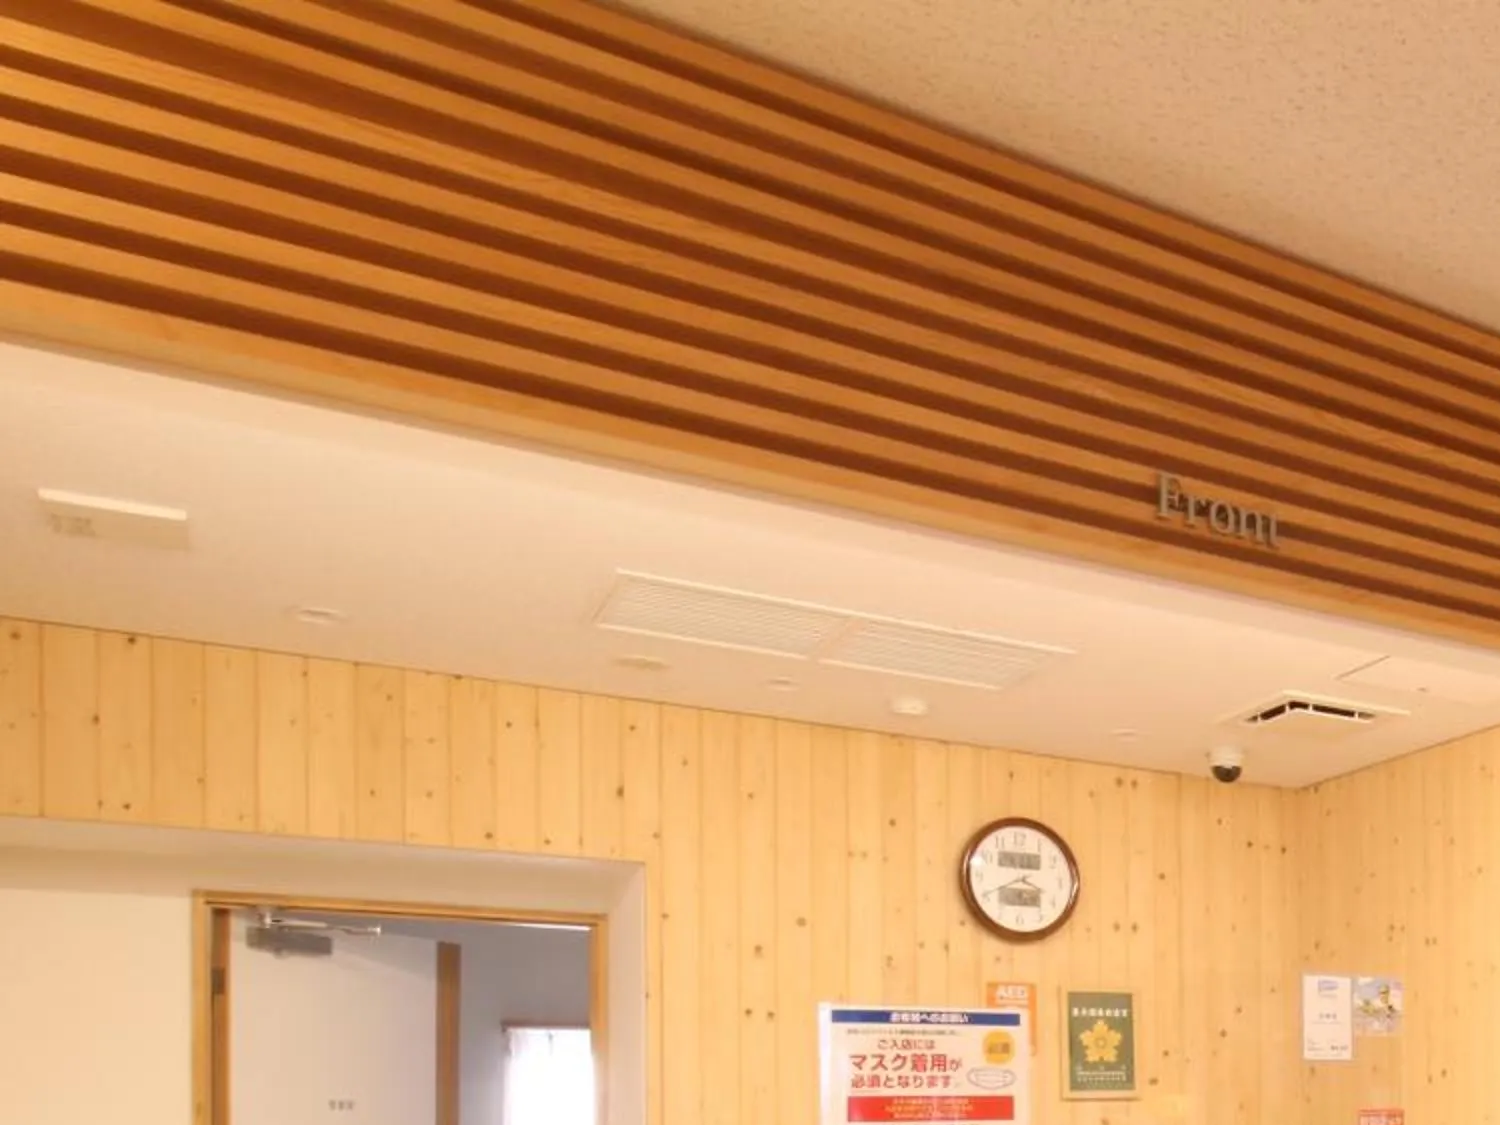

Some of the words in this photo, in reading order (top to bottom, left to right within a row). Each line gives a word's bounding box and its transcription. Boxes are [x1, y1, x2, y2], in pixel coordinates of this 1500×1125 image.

[1157, 470, 1279, 549] Front
[876, 1038, 936, 1051] ご入店には
[849, 1053, 963, 1073] マスク着用が
